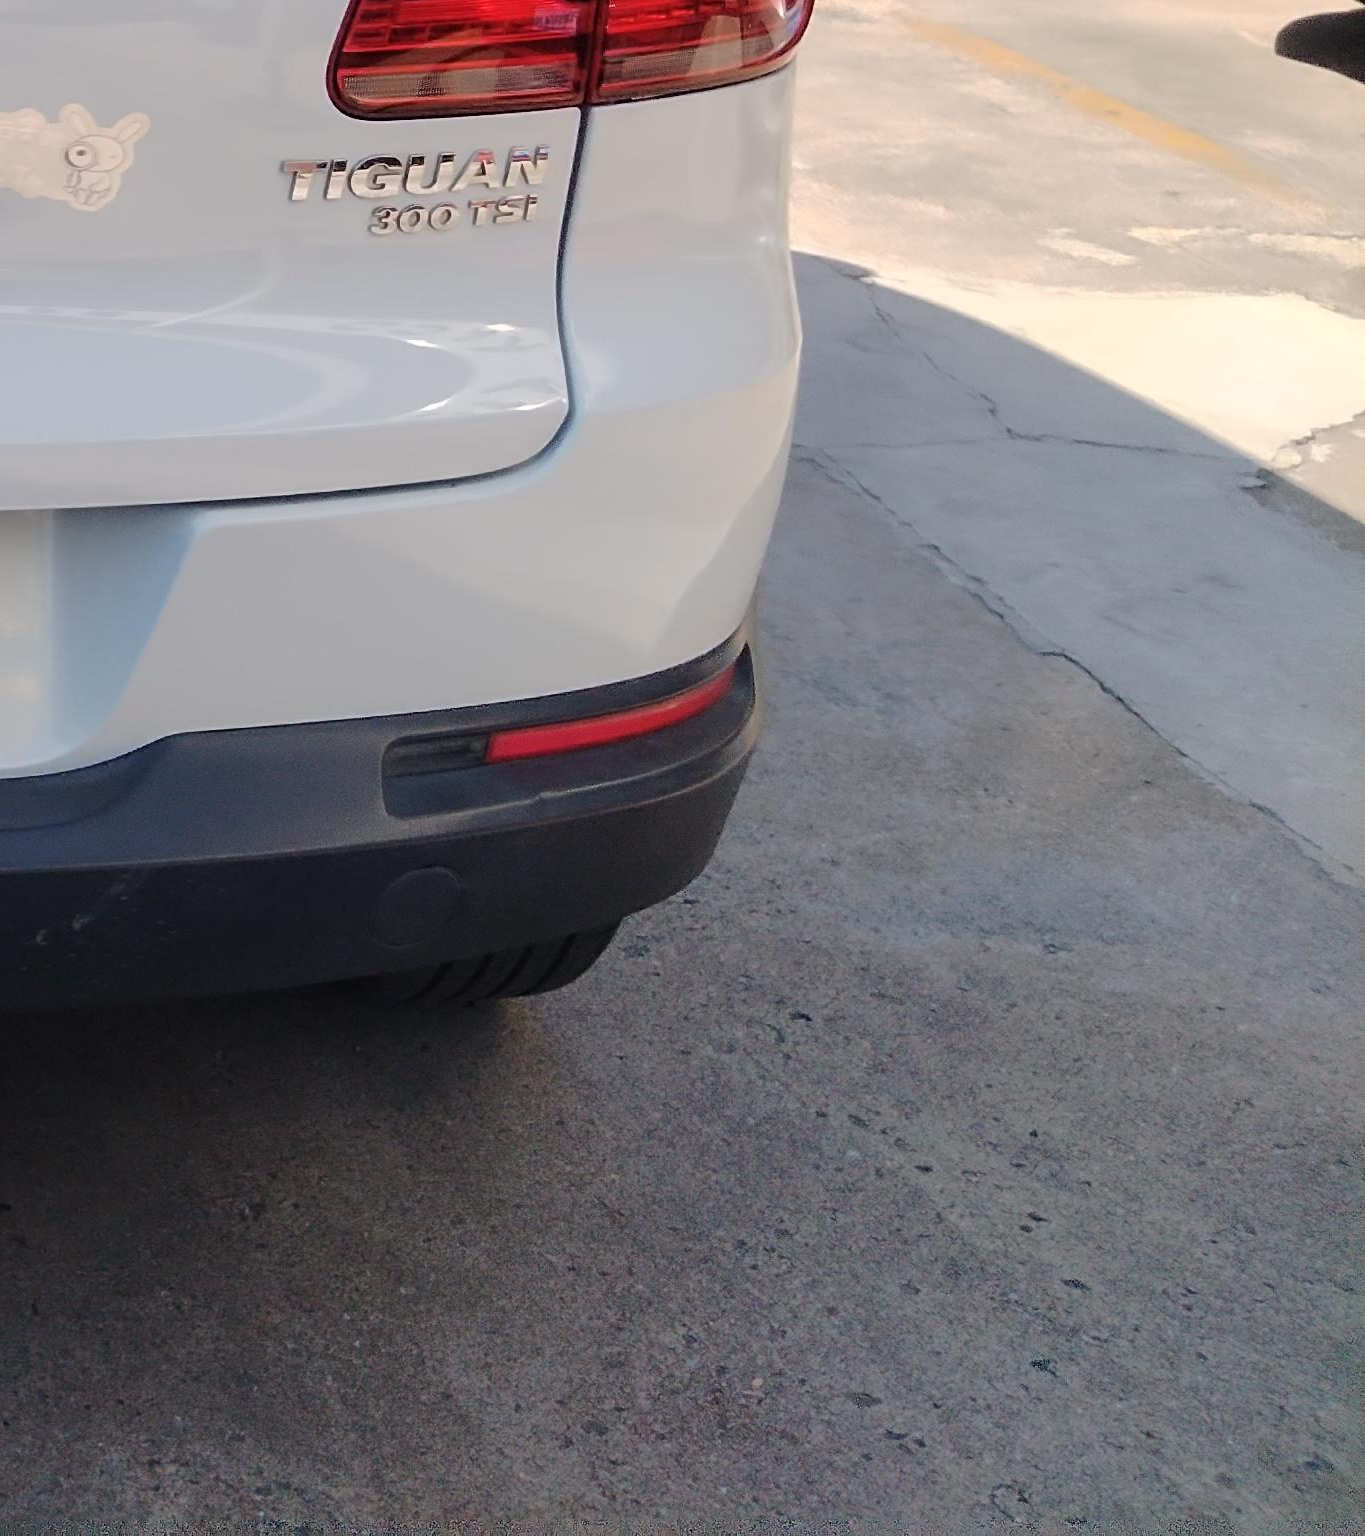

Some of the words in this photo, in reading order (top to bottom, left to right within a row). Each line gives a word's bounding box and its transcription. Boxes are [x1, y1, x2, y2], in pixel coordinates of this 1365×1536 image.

[281, 143, 551, 201] TIGUAN
[370, 202, 463, 235] 300
[468, 193, 539, 226] TSI
